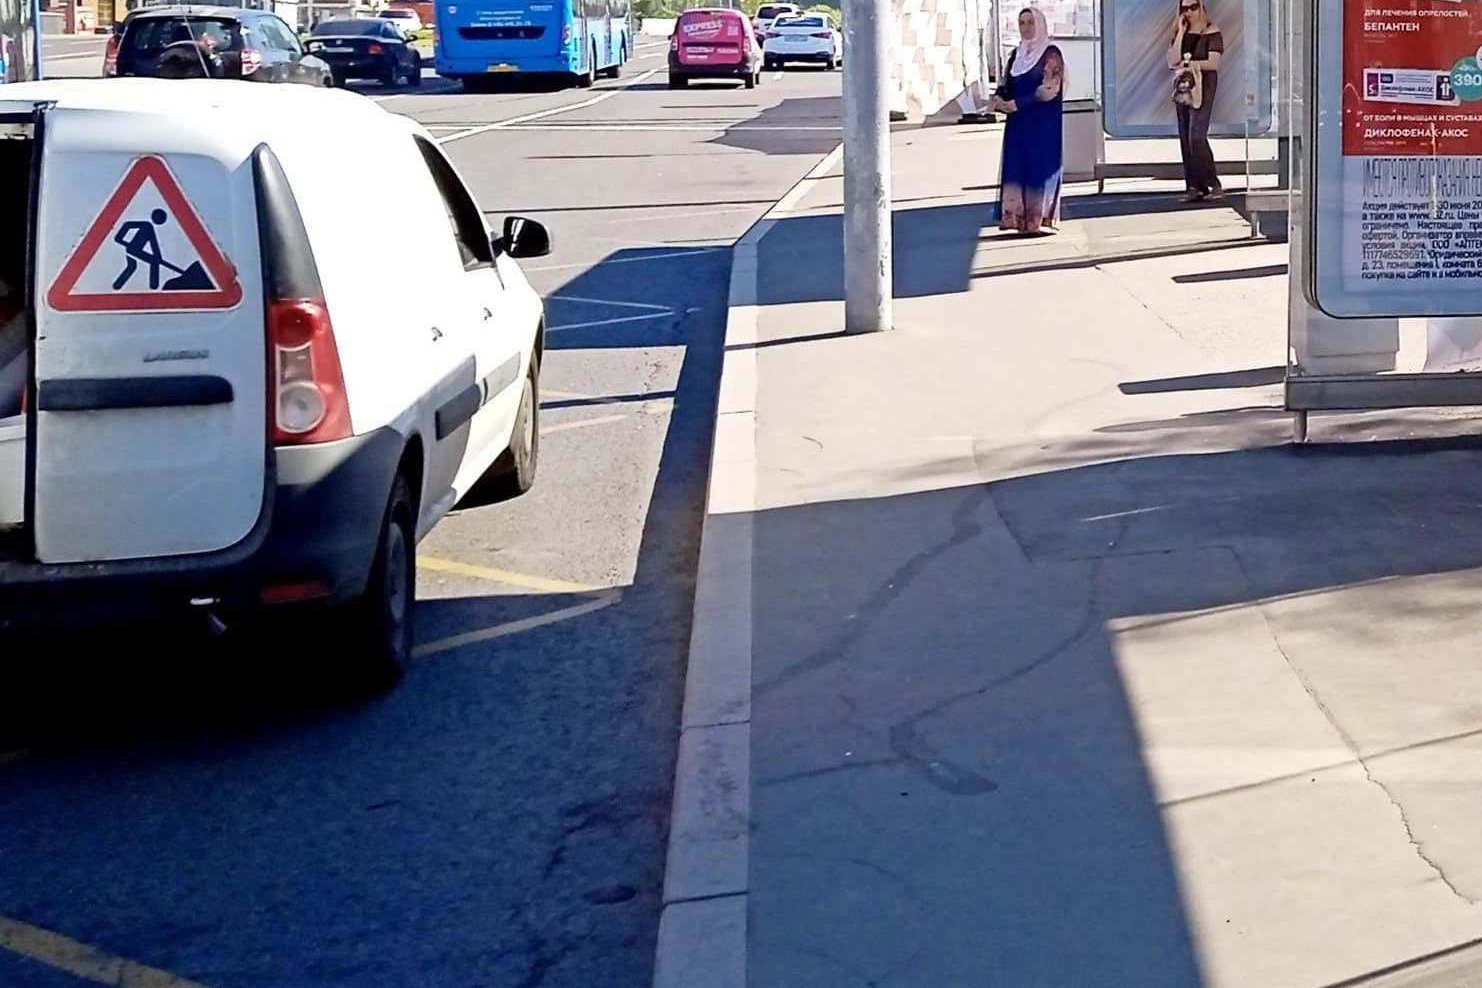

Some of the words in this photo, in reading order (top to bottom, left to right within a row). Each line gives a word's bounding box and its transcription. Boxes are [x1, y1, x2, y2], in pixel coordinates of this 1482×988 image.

[1364, 22, 1420, 31] БЕПАНТЕН
[1454, 74, 1482, 86] 390
[1364, 128, 1469, 138] ДИКЛОФЕНАК-АКОС
